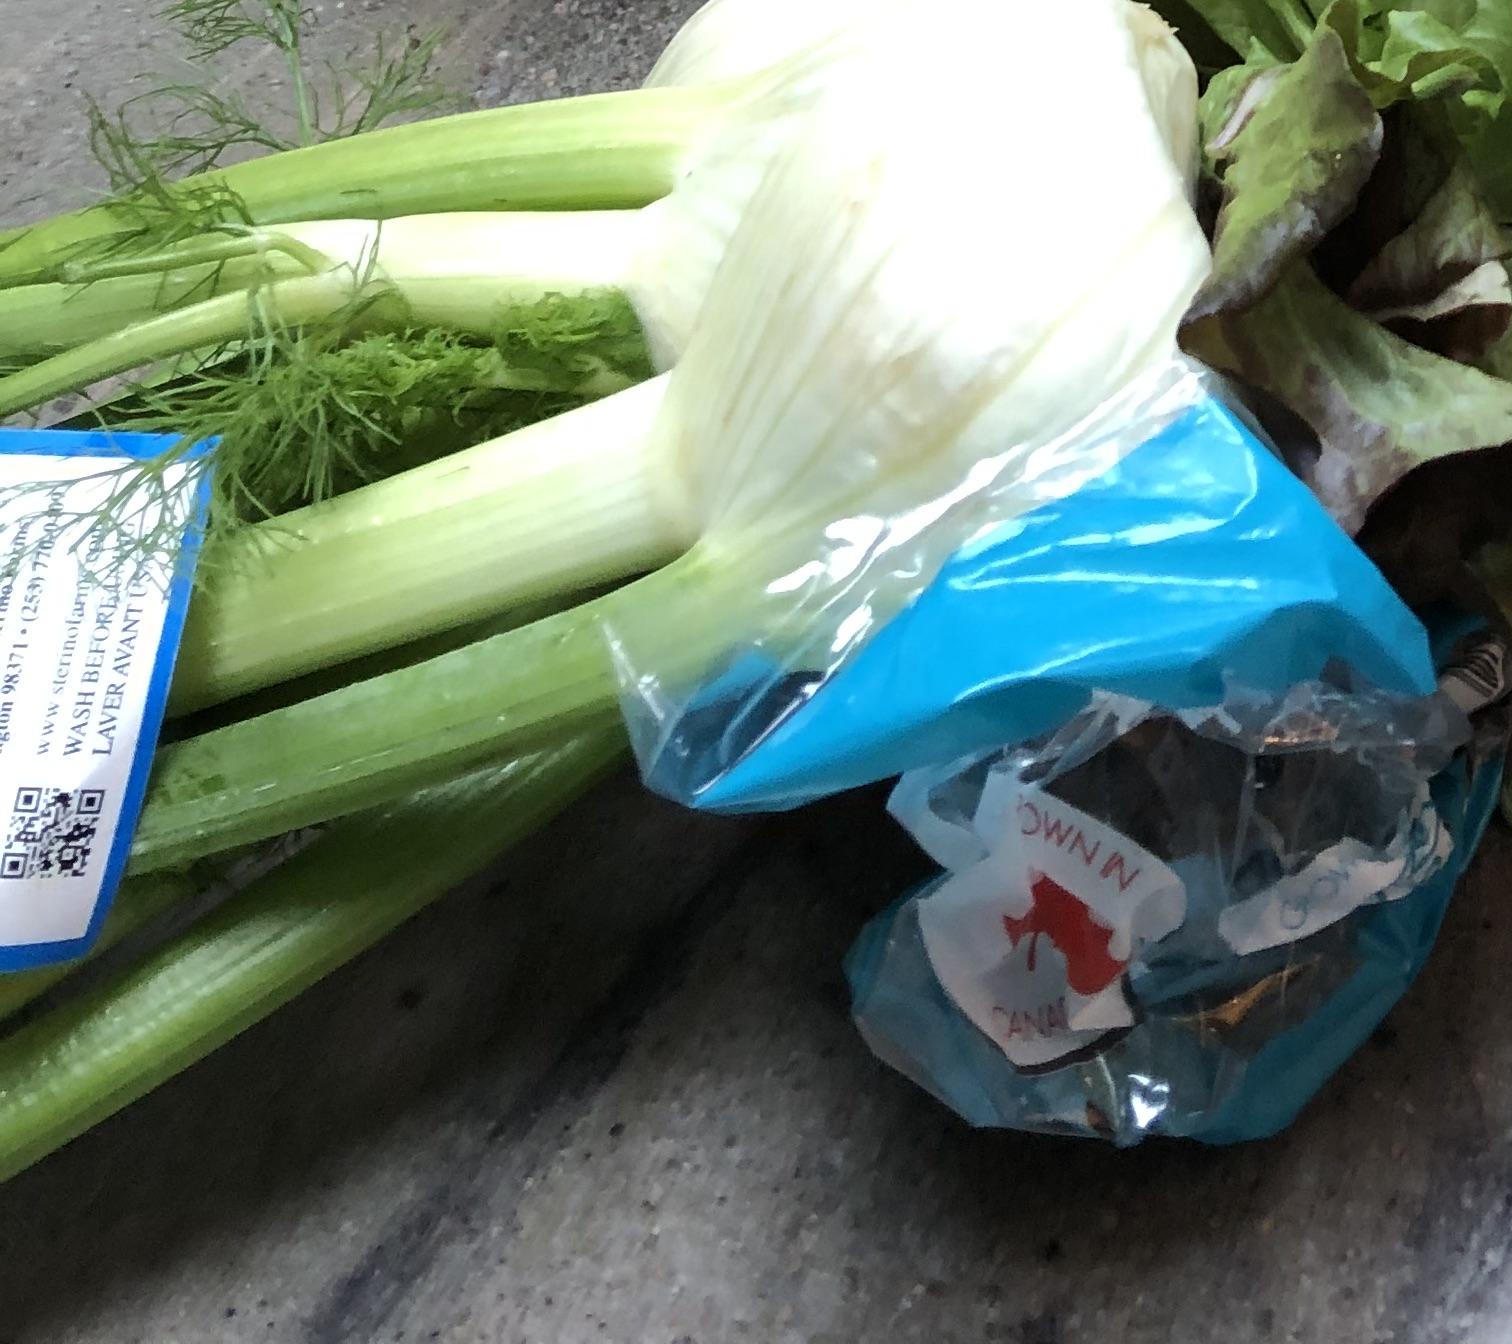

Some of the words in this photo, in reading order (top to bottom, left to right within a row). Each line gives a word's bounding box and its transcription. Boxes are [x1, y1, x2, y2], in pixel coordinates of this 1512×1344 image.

[1, 644, 29, 696] 98371
[20, 577, 46, 622] (253)
[63, 691, 97, 757] WASH
[80, 599, 119, 685] BEFORE
[92, 682, 127, 757] LAVER
[112, 604, 144, 678] AVANT
